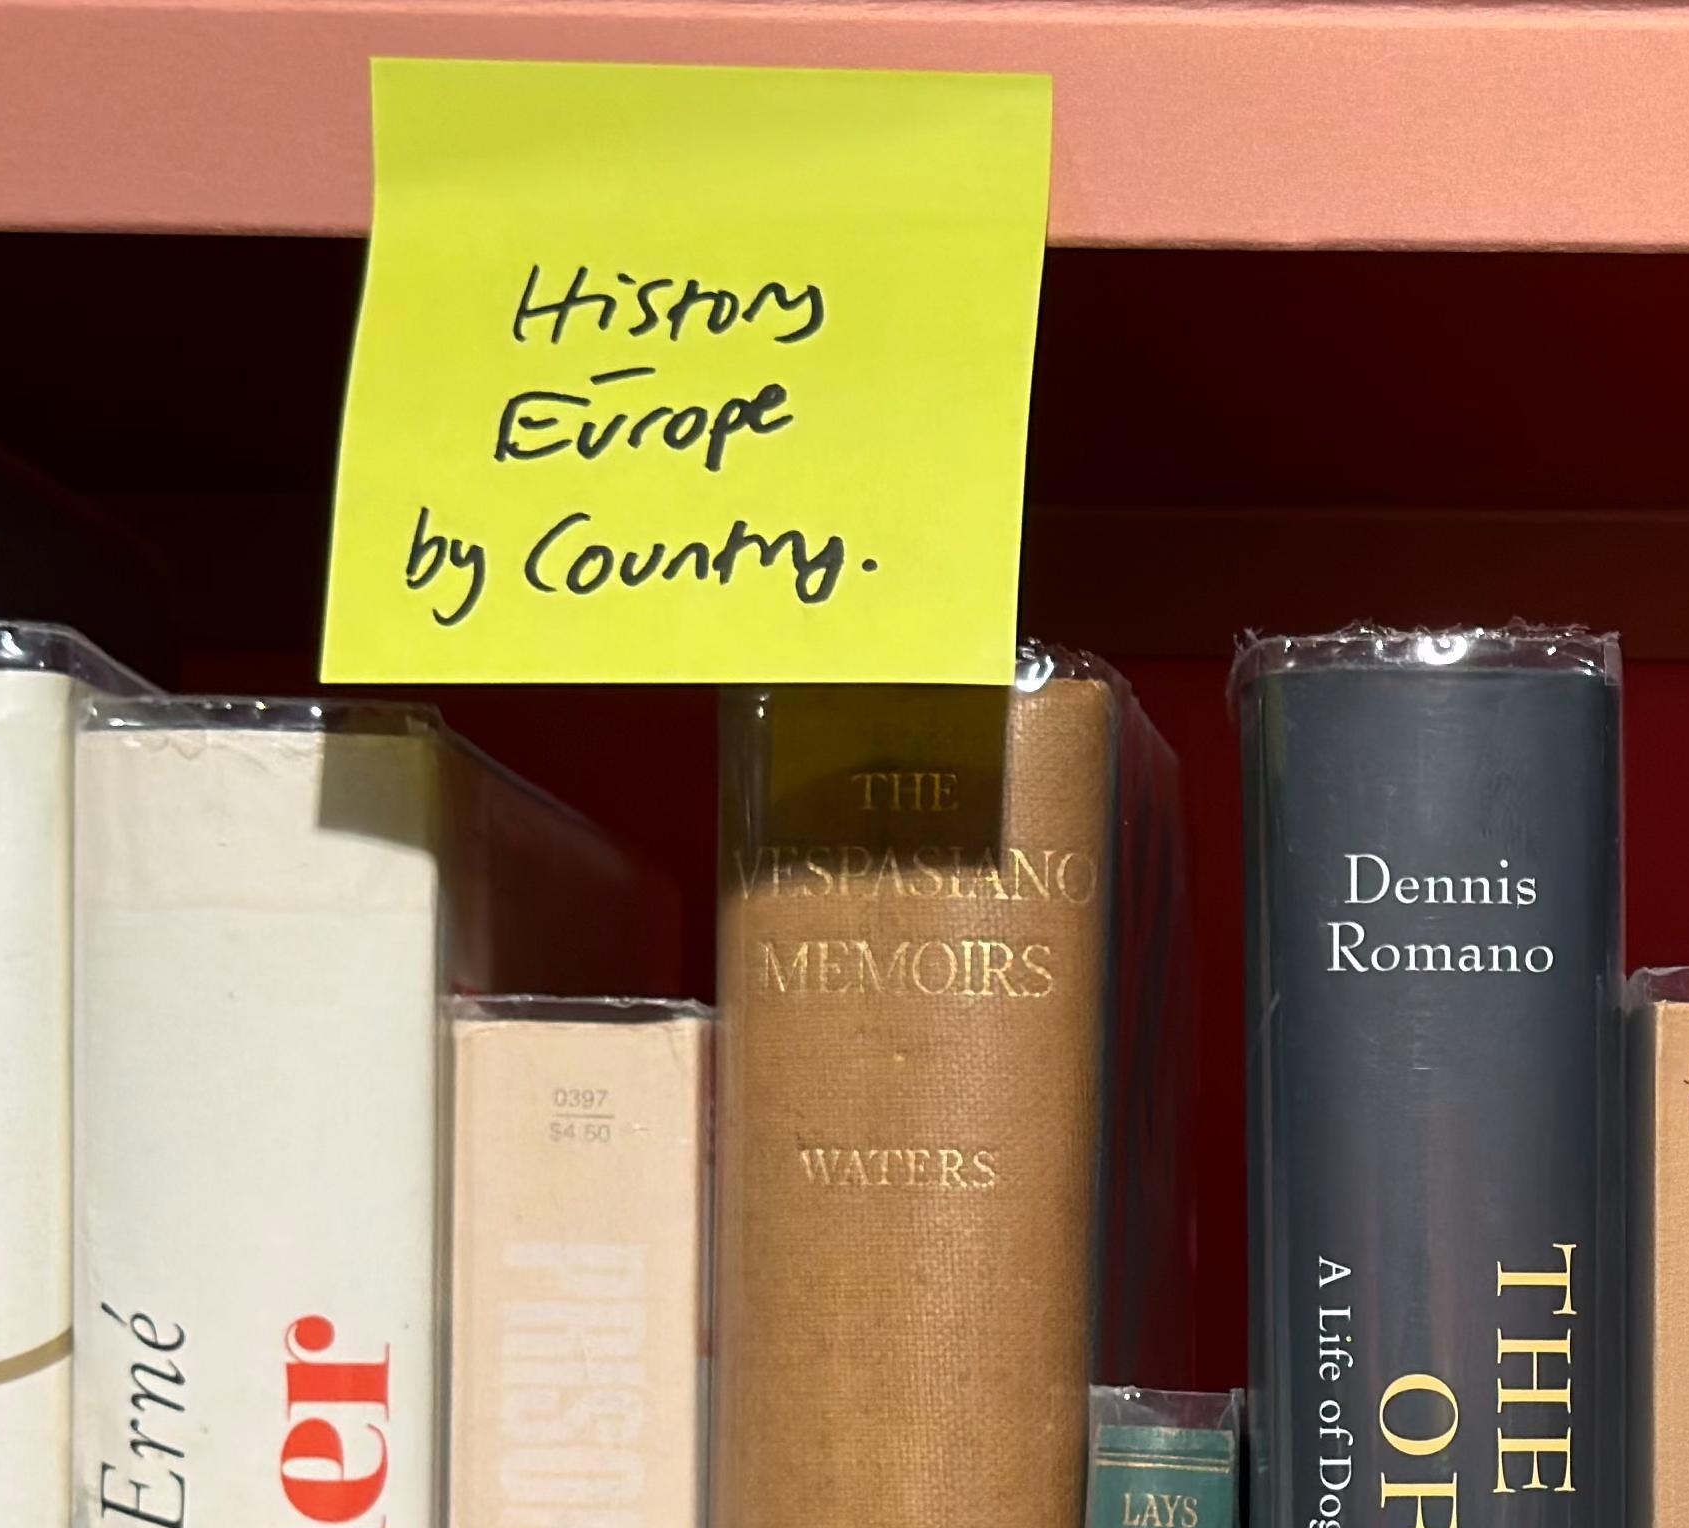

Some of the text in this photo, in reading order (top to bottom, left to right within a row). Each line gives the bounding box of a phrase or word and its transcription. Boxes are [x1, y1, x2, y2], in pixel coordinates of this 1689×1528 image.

[513, 265, 824, 344] History
[494, 384, 793, 472] Europe
[406, 506, 485, 626] by
[851, 773, 959, 812] THE
[732, 845, 1099, 905] VESPASIANO
[1345, 854, 1537, 905] Dennis
[759, 939, 1055, 998] MEMOIRS
[1327, 922, 1555, 972] Romano
[800, 1148, 997, 1188] WATERS
[1319, 1256, 1351, 1288] A
[1319, 1306, 1353, 1381] Life
[1493, 1244, 1577, 1493] THE
[1319, 1400, 1353, 1446] of
[1124, 1492, 1198, 1528] LAYS
